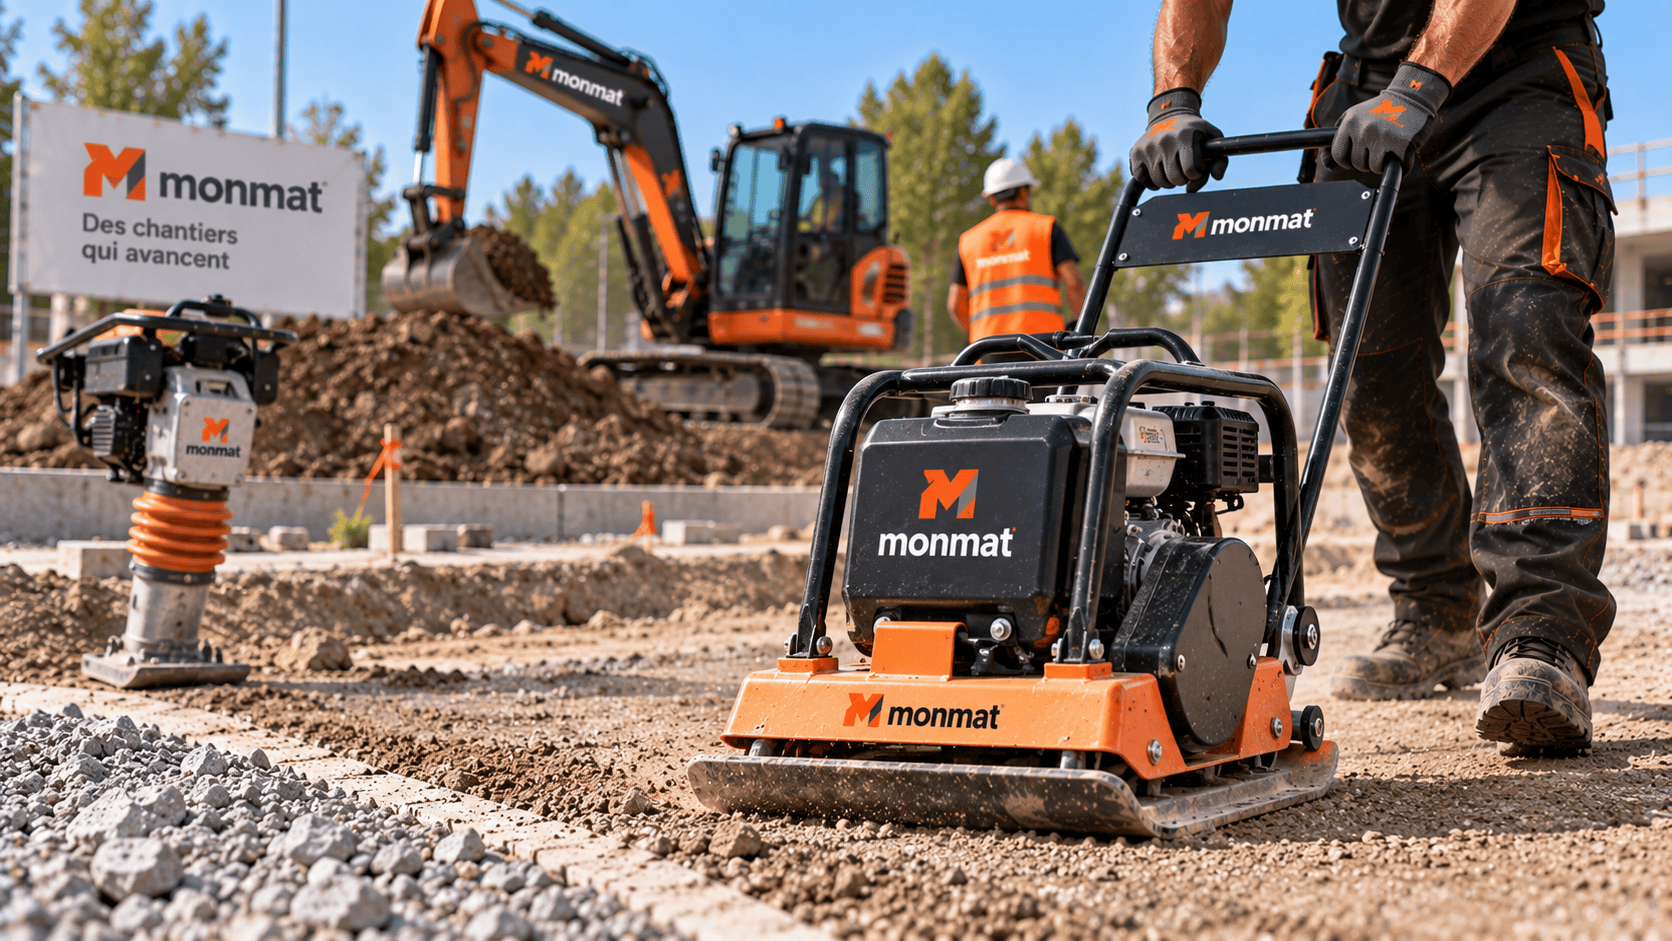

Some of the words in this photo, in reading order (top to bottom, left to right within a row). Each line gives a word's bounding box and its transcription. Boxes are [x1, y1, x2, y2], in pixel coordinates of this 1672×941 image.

[551, 69, 624, 107] monmat
[159, 171, 323, 214] monmat
[82, 213, 127, 236] Des
[132, 217, 239, 245] chantiers
[1210, 209, 1312, 236] monmat
[81, 241, 118, 264] qui
[125, 243, 231, 271] avancent
[186, 444, 241, 458] monmat
[878, 528, 1014, 557] monmat
[887, 705, 1001, 730] monmat
